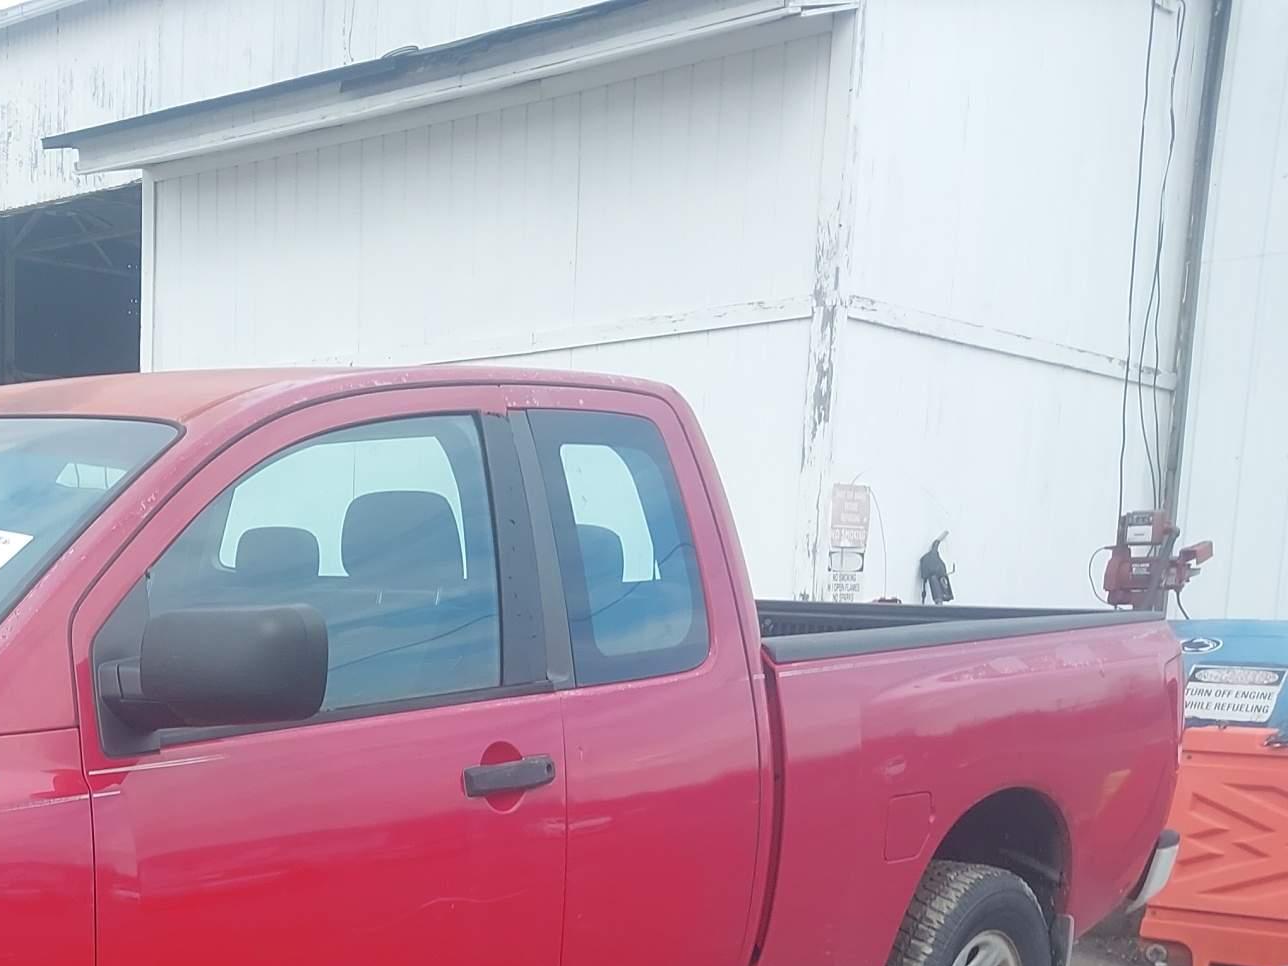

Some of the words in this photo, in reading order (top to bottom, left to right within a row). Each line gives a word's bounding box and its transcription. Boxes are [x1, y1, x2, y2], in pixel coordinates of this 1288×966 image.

[1185, 687, 1213, 697] TURN
[1214, 688, 1232, 699] OFF
[1234, 690, 1274, 701] ENGINE
[1213, 702, 1270, 714] REFUELING
